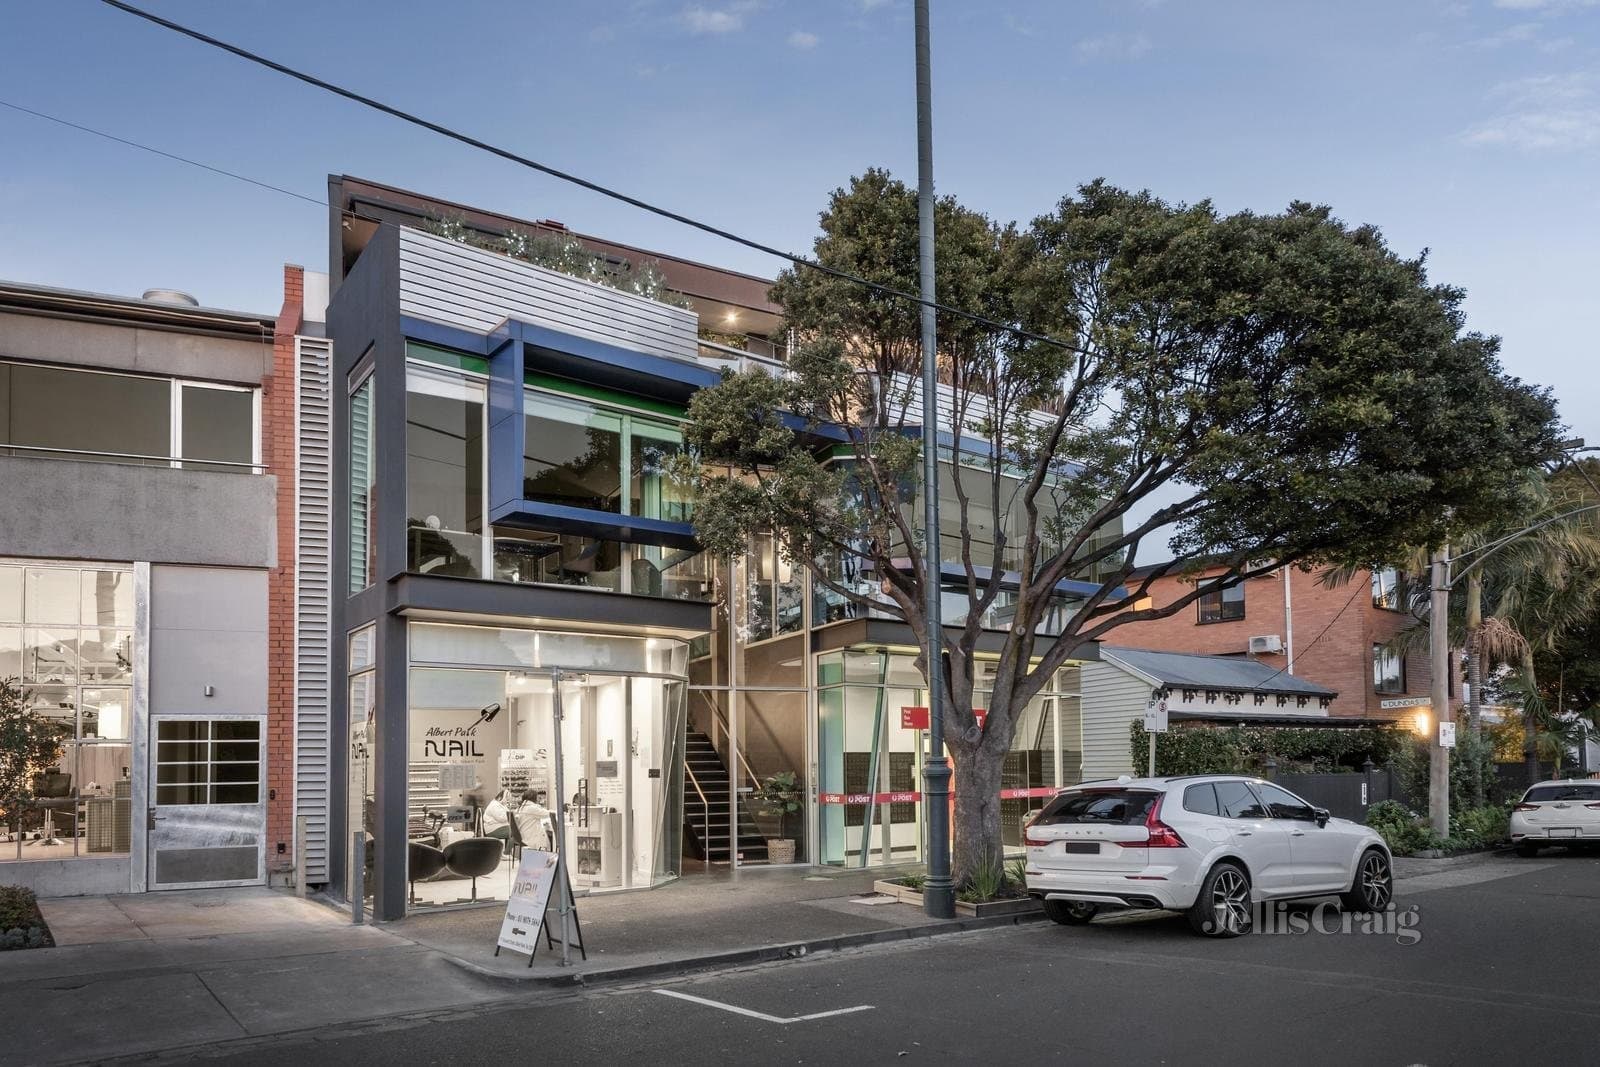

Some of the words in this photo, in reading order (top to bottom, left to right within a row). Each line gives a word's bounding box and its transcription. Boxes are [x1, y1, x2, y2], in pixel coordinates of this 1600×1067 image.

[1388, 699, 1420, 707] DUNDAS
[425, 727, 453, 737] Albert
[454, 727, 477, 737] Park
[424, 740, 484, 757] NAIL
[855, 795, 870, 803] POST
[897, 793, 912, 801] POST
